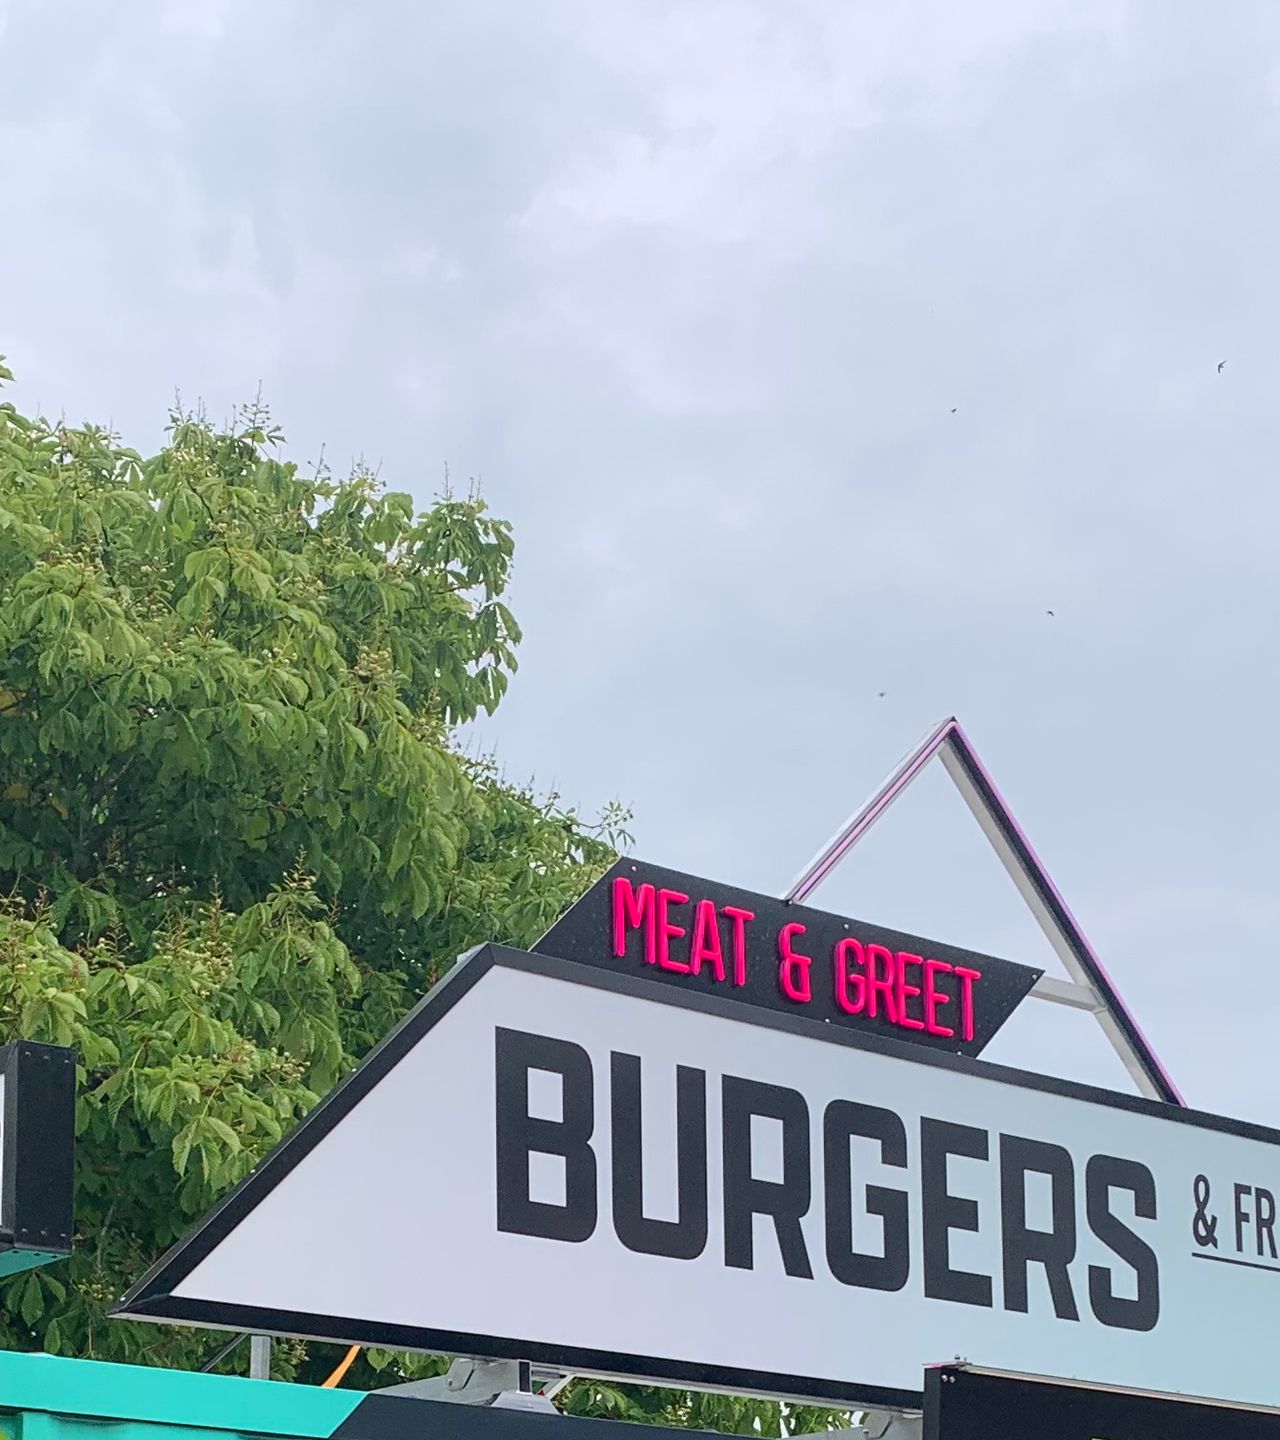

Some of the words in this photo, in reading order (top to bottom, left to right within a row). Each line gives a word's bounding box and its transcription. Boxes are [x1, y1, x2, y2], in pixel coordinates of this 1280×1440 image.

[614, 876, 755, 986] MEAT
[779, 922, 812, 1002] &
[835, 937, 982, 1041] GREET
[495, 1025, 1160, 1332] BURGERS
[1192, 1173, 1218, 1250] &
